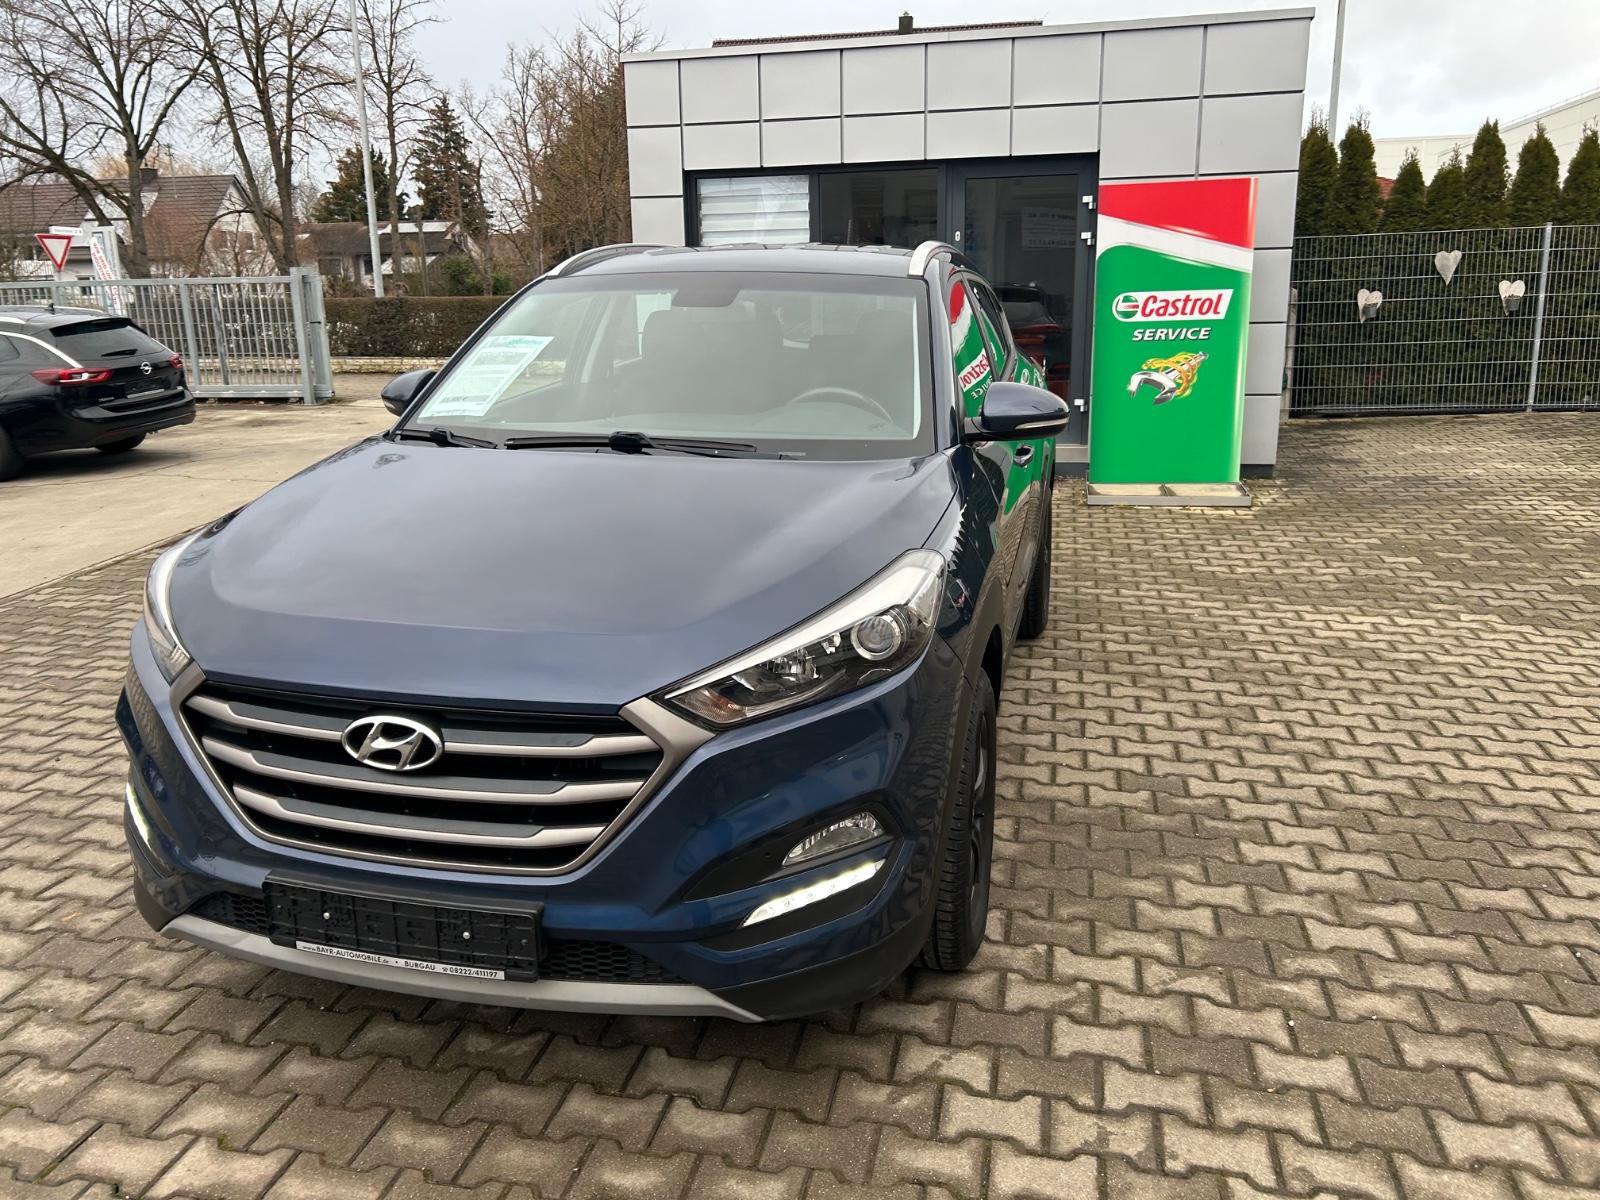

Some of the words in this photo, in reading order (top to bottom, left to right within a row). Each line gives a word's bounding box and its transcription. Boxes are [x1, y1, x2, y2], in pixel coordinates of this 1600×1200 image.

[1141, 293, 1223, 317] Castrol
[1132, 327, 1212, 341] SERVICE
[404, 960, 436, 971] BURGAU
[449, 966, 498, 978] 08222/411197
